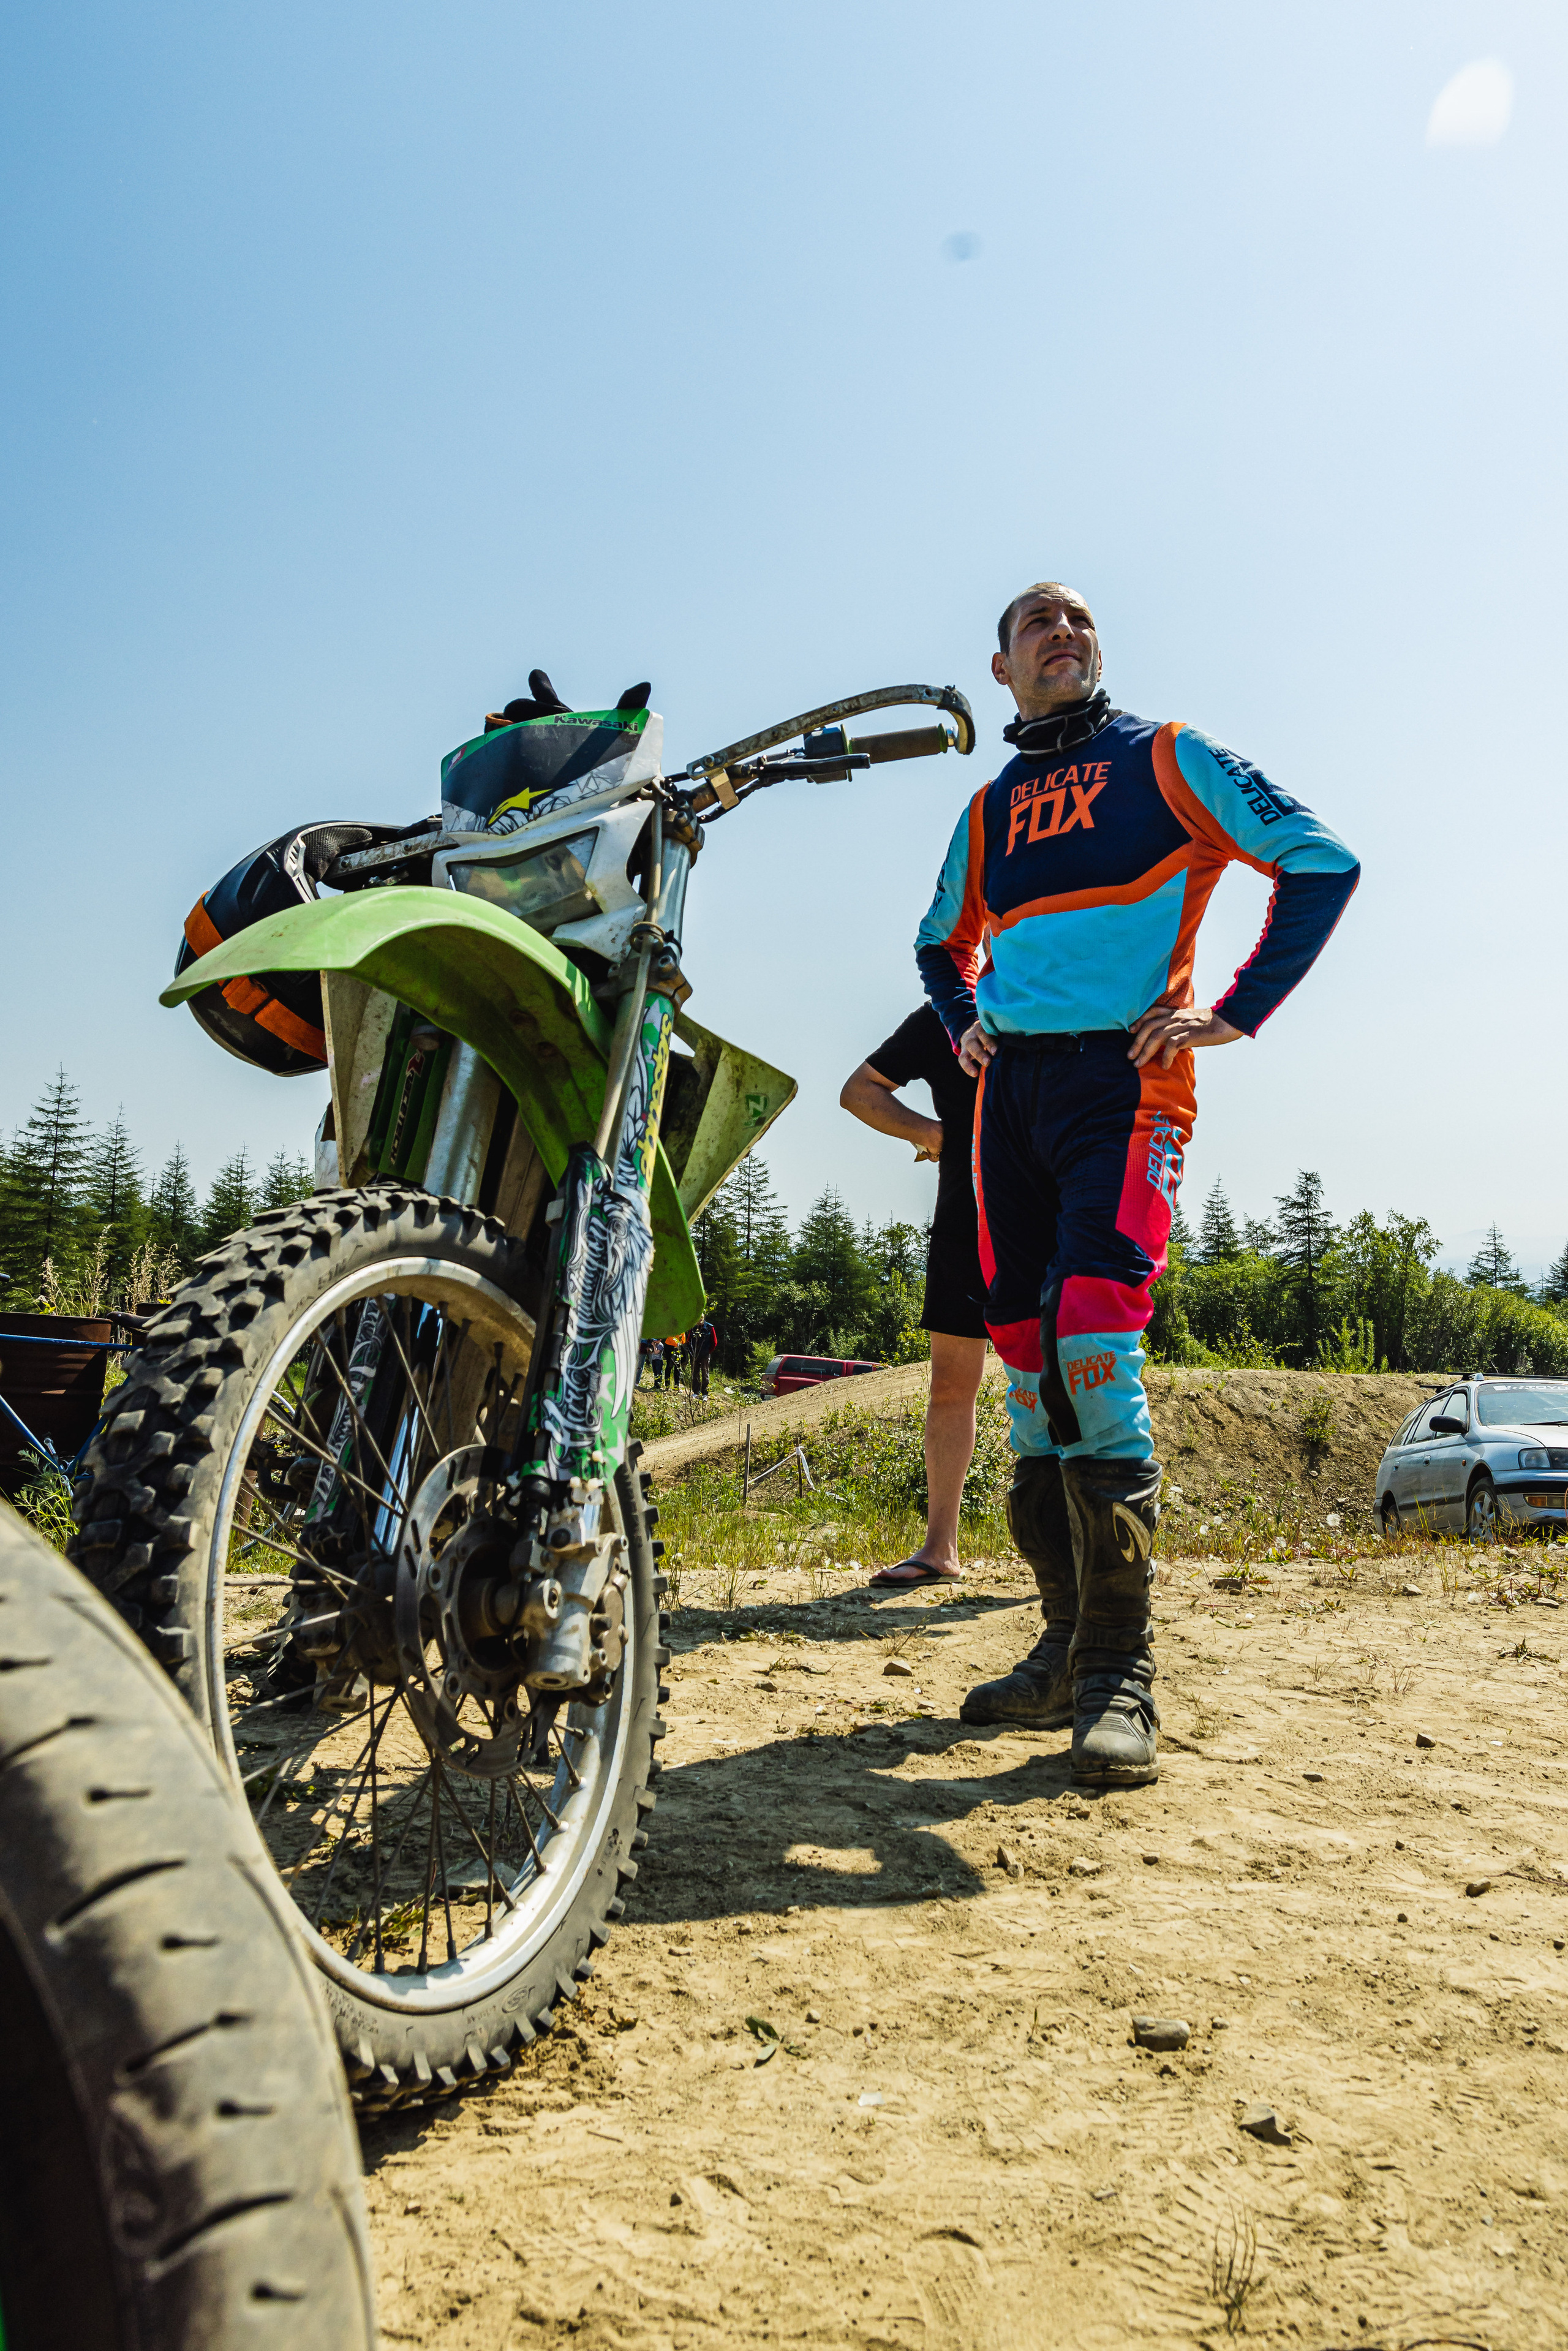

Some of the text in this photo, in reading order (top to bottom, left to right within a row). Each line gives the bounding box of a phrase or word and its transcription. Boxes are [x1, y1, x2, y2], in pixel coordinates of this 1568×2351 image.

[554, 715, 638, 731] Kawasaki
[1010, 761, 1112, 807] DELICATE
[1005, 782, 1108, 857] FOX
[1067, 1351, 1115, 1372] DELICATE
[1068, 1360, 1117, 1395] FOX
